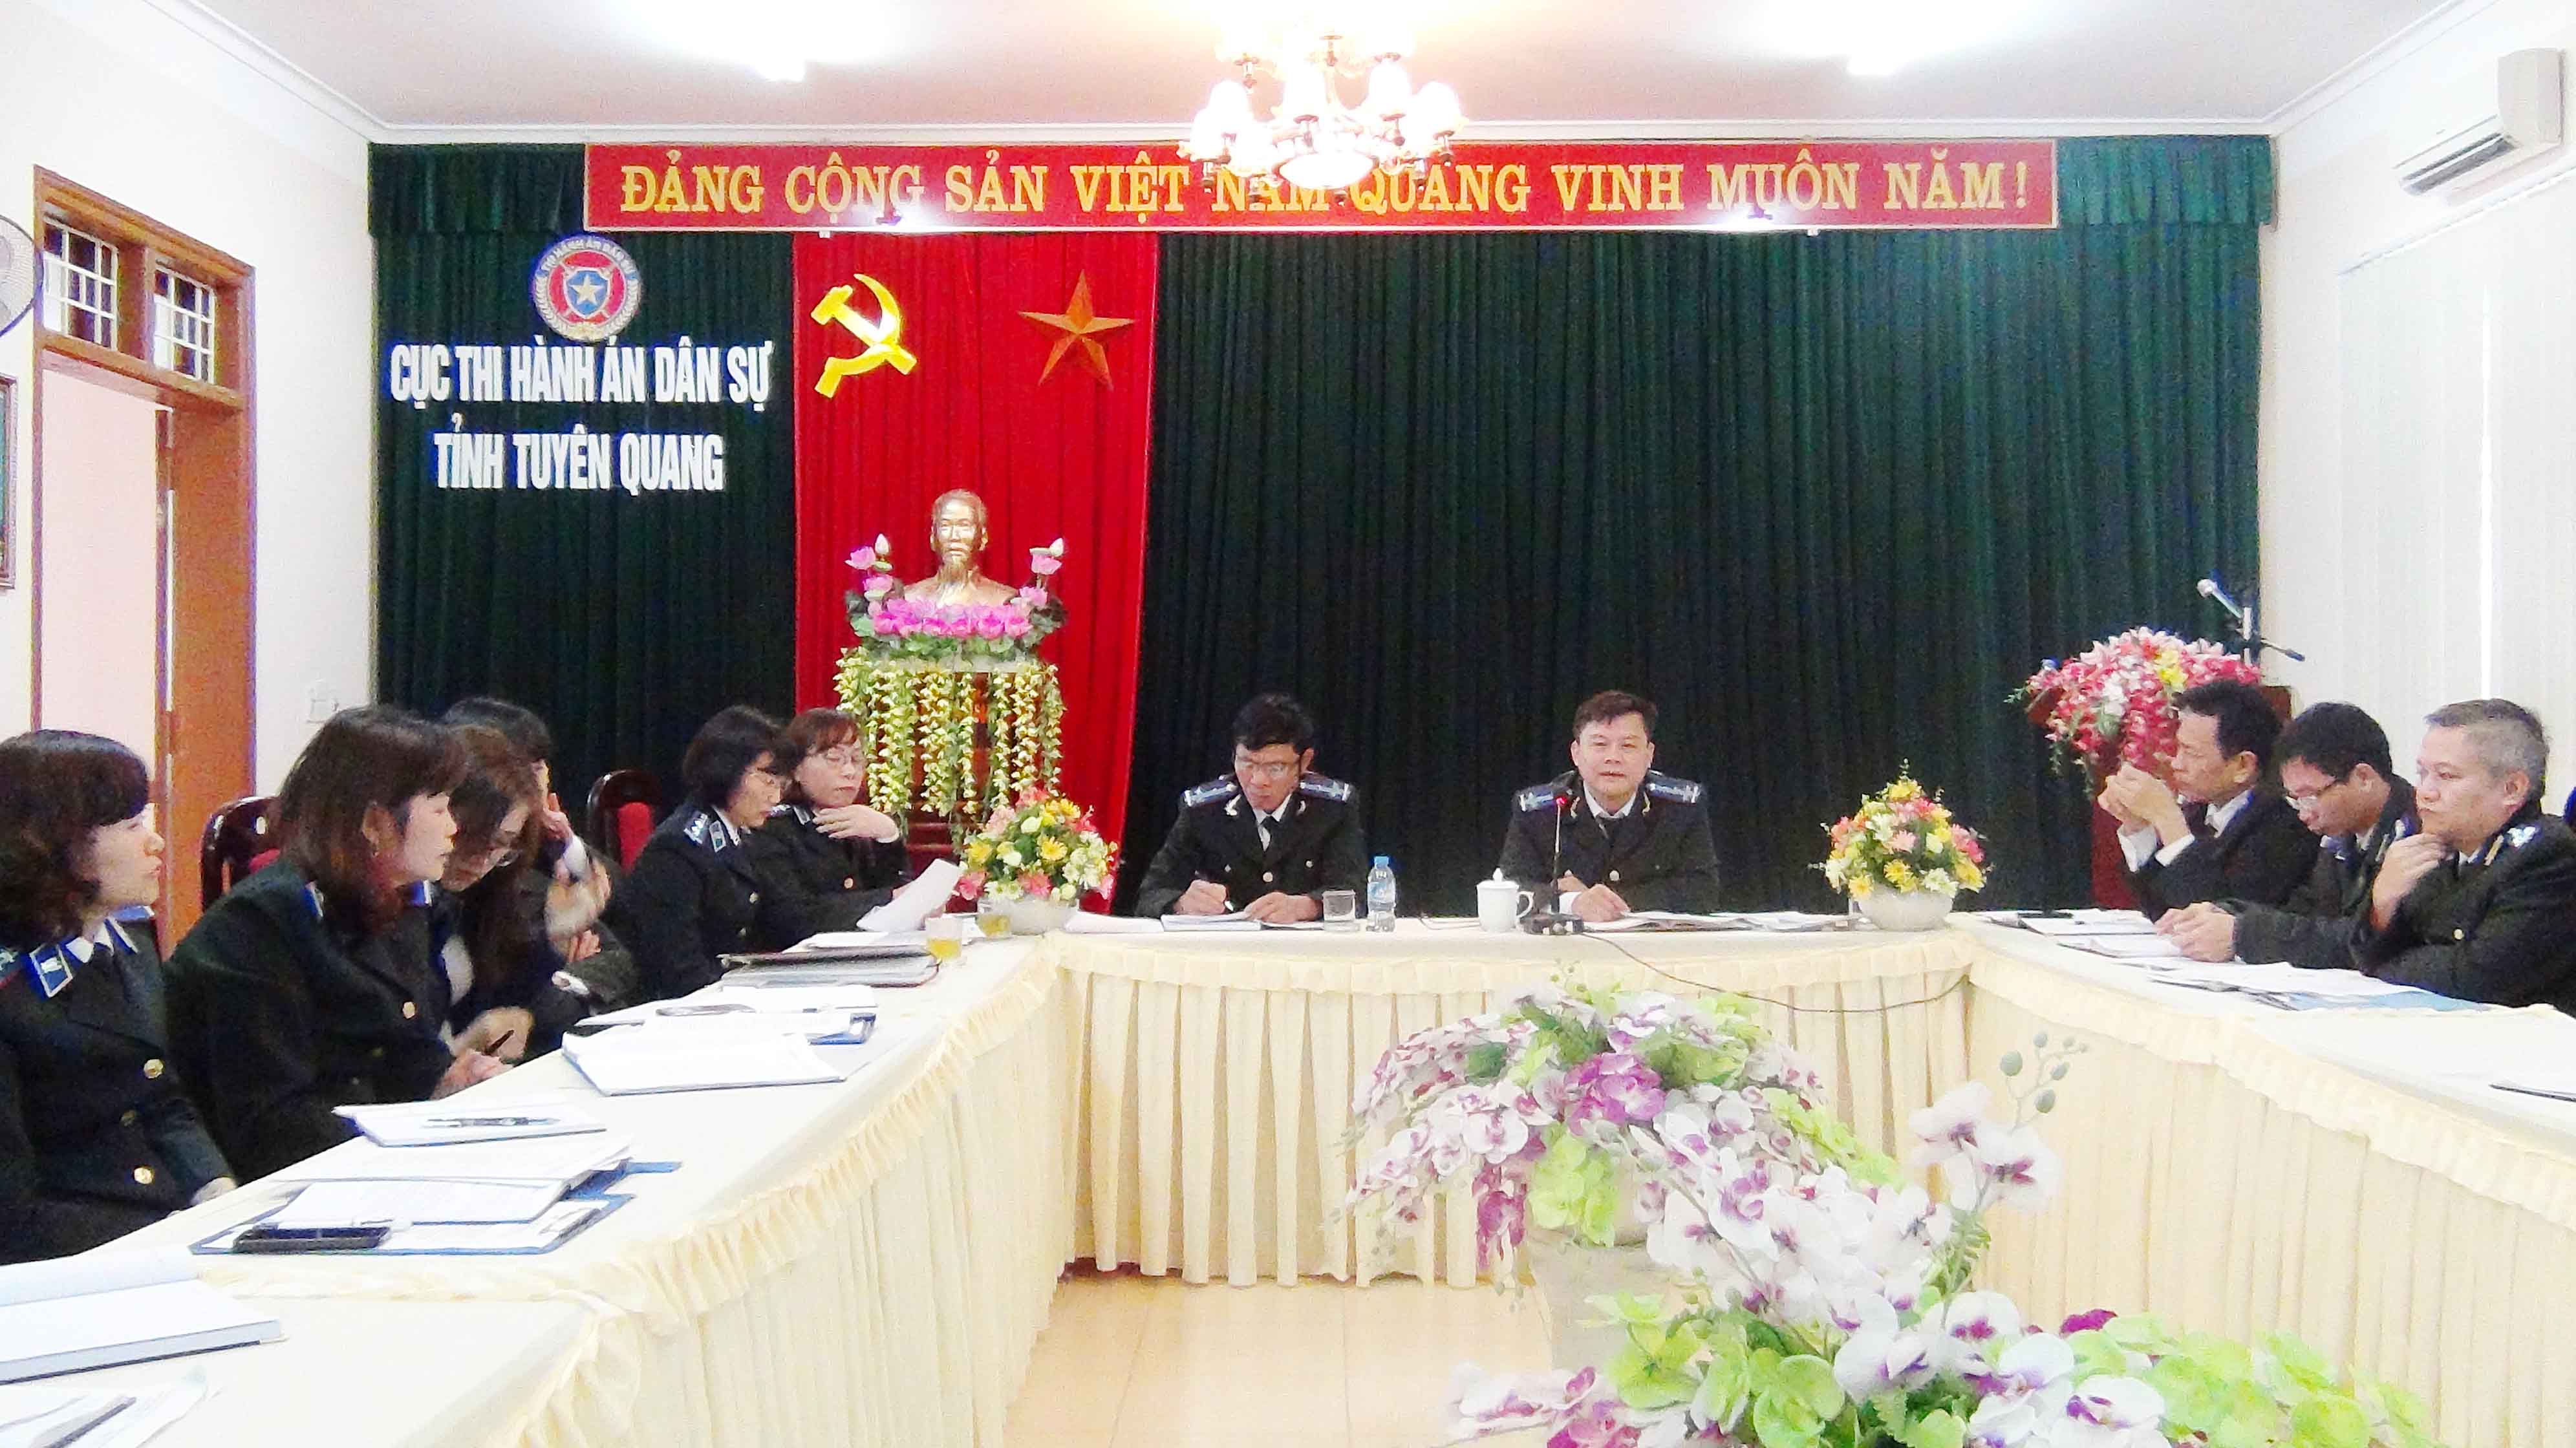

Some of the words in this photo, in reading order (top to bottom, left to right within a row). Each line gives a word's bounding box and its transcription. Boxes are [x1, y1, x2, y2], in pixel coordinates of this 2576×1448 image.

[620, 149, 765, 214] ĐẢNG
[784, 151, 925, 223] CỘNG
[945, 149, 1049, 214] SẢN
[1069, 151, 1190, 224] VIỆT
[1349, 164, 1532, 215] QUANG
[1551, 164, 1684, 214] VINH
[1706, 147, 1860, 212] MUÔN
[391, 344, 450, 409] CỤC
[455, 346, 503, 401] THI
[510, 334, 596, 402] HÀNH
[601, 335, 647, 402] ÁN
[654, 335, 720, 403] DÂN
[726, 340, 775, 412] SỰ
[434, 412, 505, 489] TỈNH
[512, 423, 612, 489] TUYÊN
[619, 432, 724, 496] QUANG
